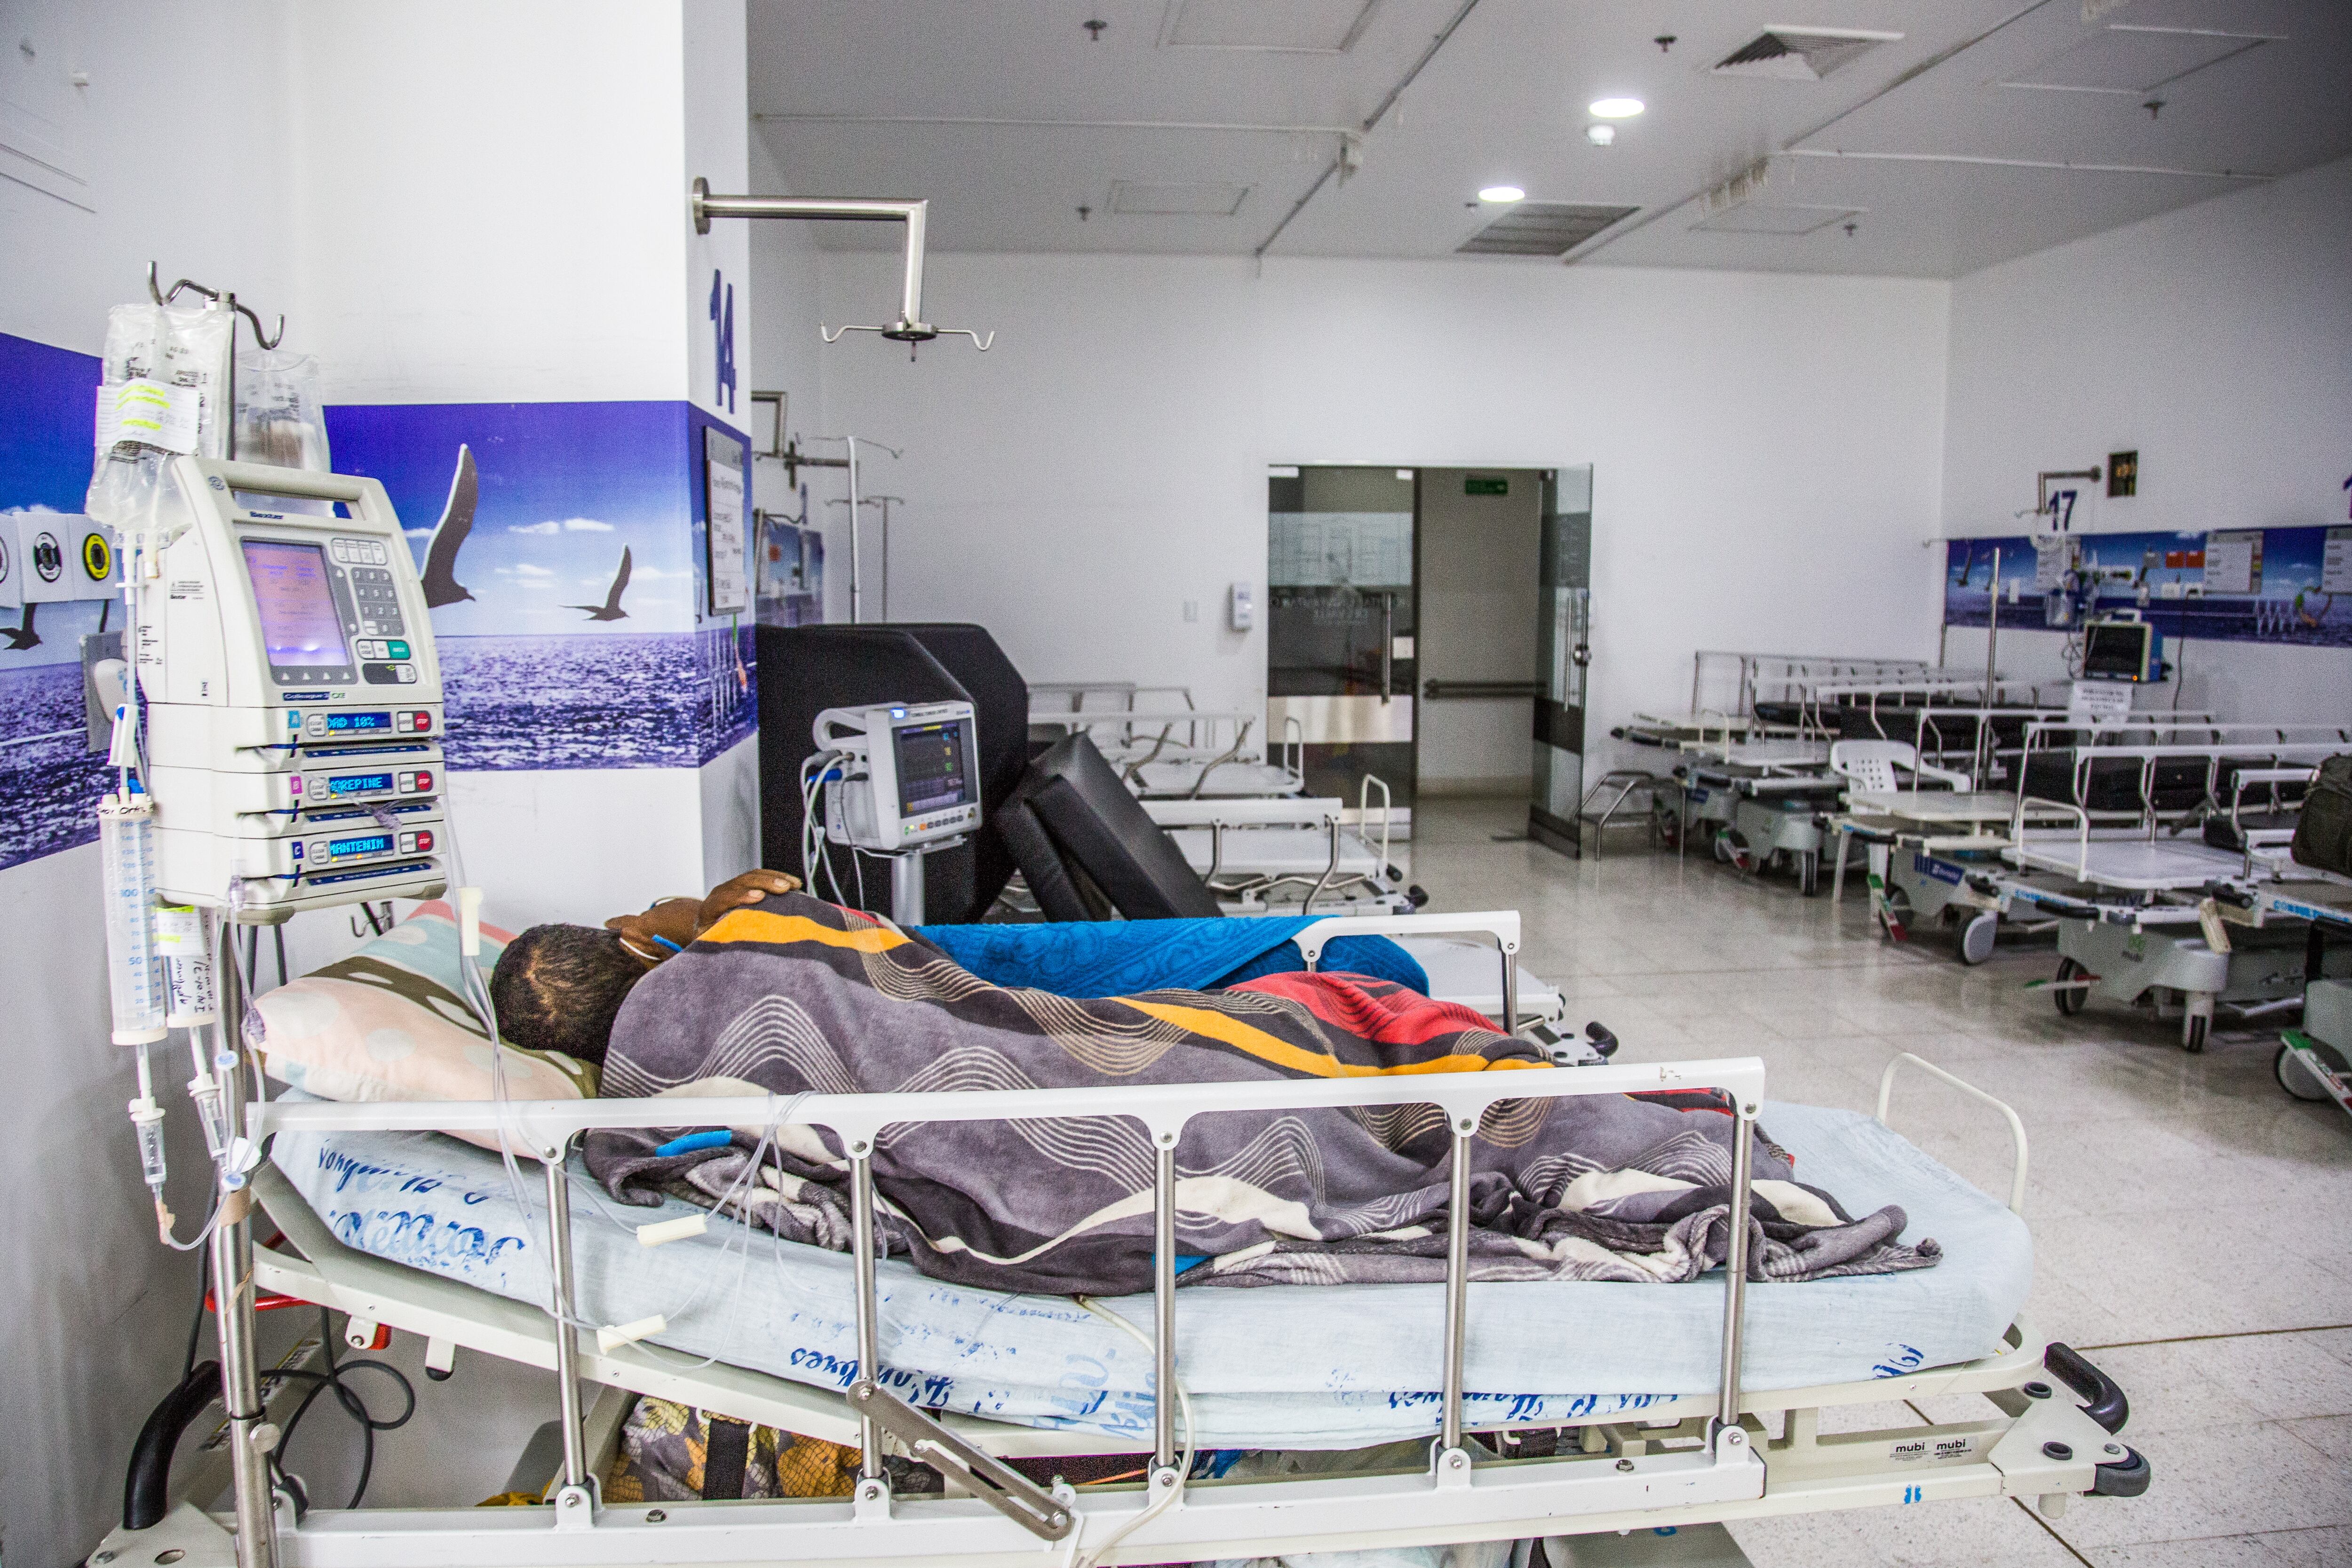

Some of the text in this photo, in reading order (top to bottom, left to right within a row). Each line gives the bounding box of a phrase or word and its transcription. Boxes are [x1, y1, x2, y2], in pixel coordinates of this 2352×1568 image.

[709, 268, 737, 414] 14
[249, 511, 284, 519] Baxter
[2048, 489, 2078, 532] 17
[1895, 1441, 1925, 1453] mubi
[1936, 1439, 1966, 1450] mubi
